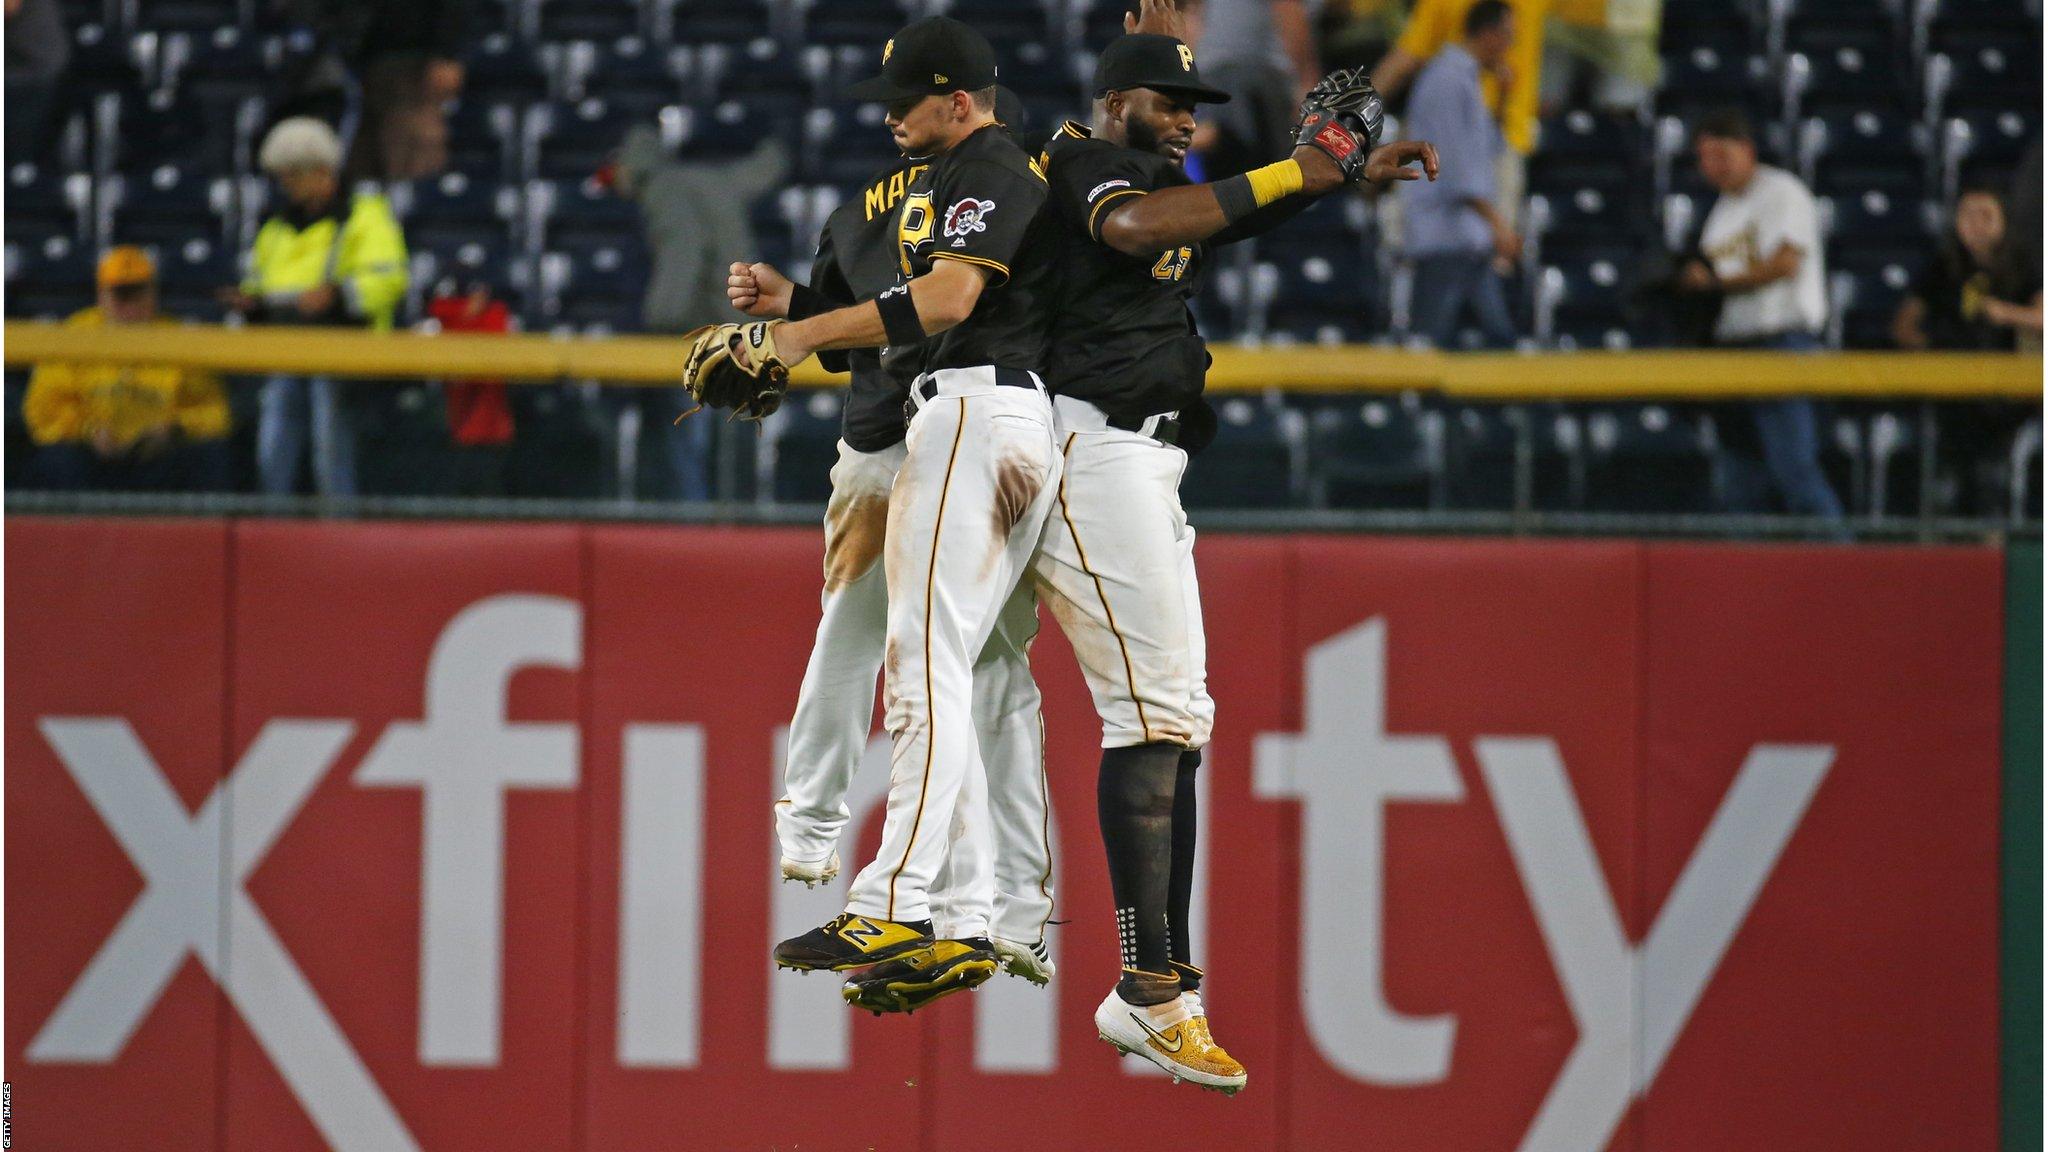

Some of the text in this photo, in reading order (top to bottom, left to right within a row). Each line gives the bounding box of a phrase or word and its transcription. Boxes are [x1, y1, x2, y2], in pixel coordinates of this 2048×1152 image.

[1176, 44, 1193, 71] P
[24, 593, 1837, 1152] xfity
[844, 918, 884, 947] N
